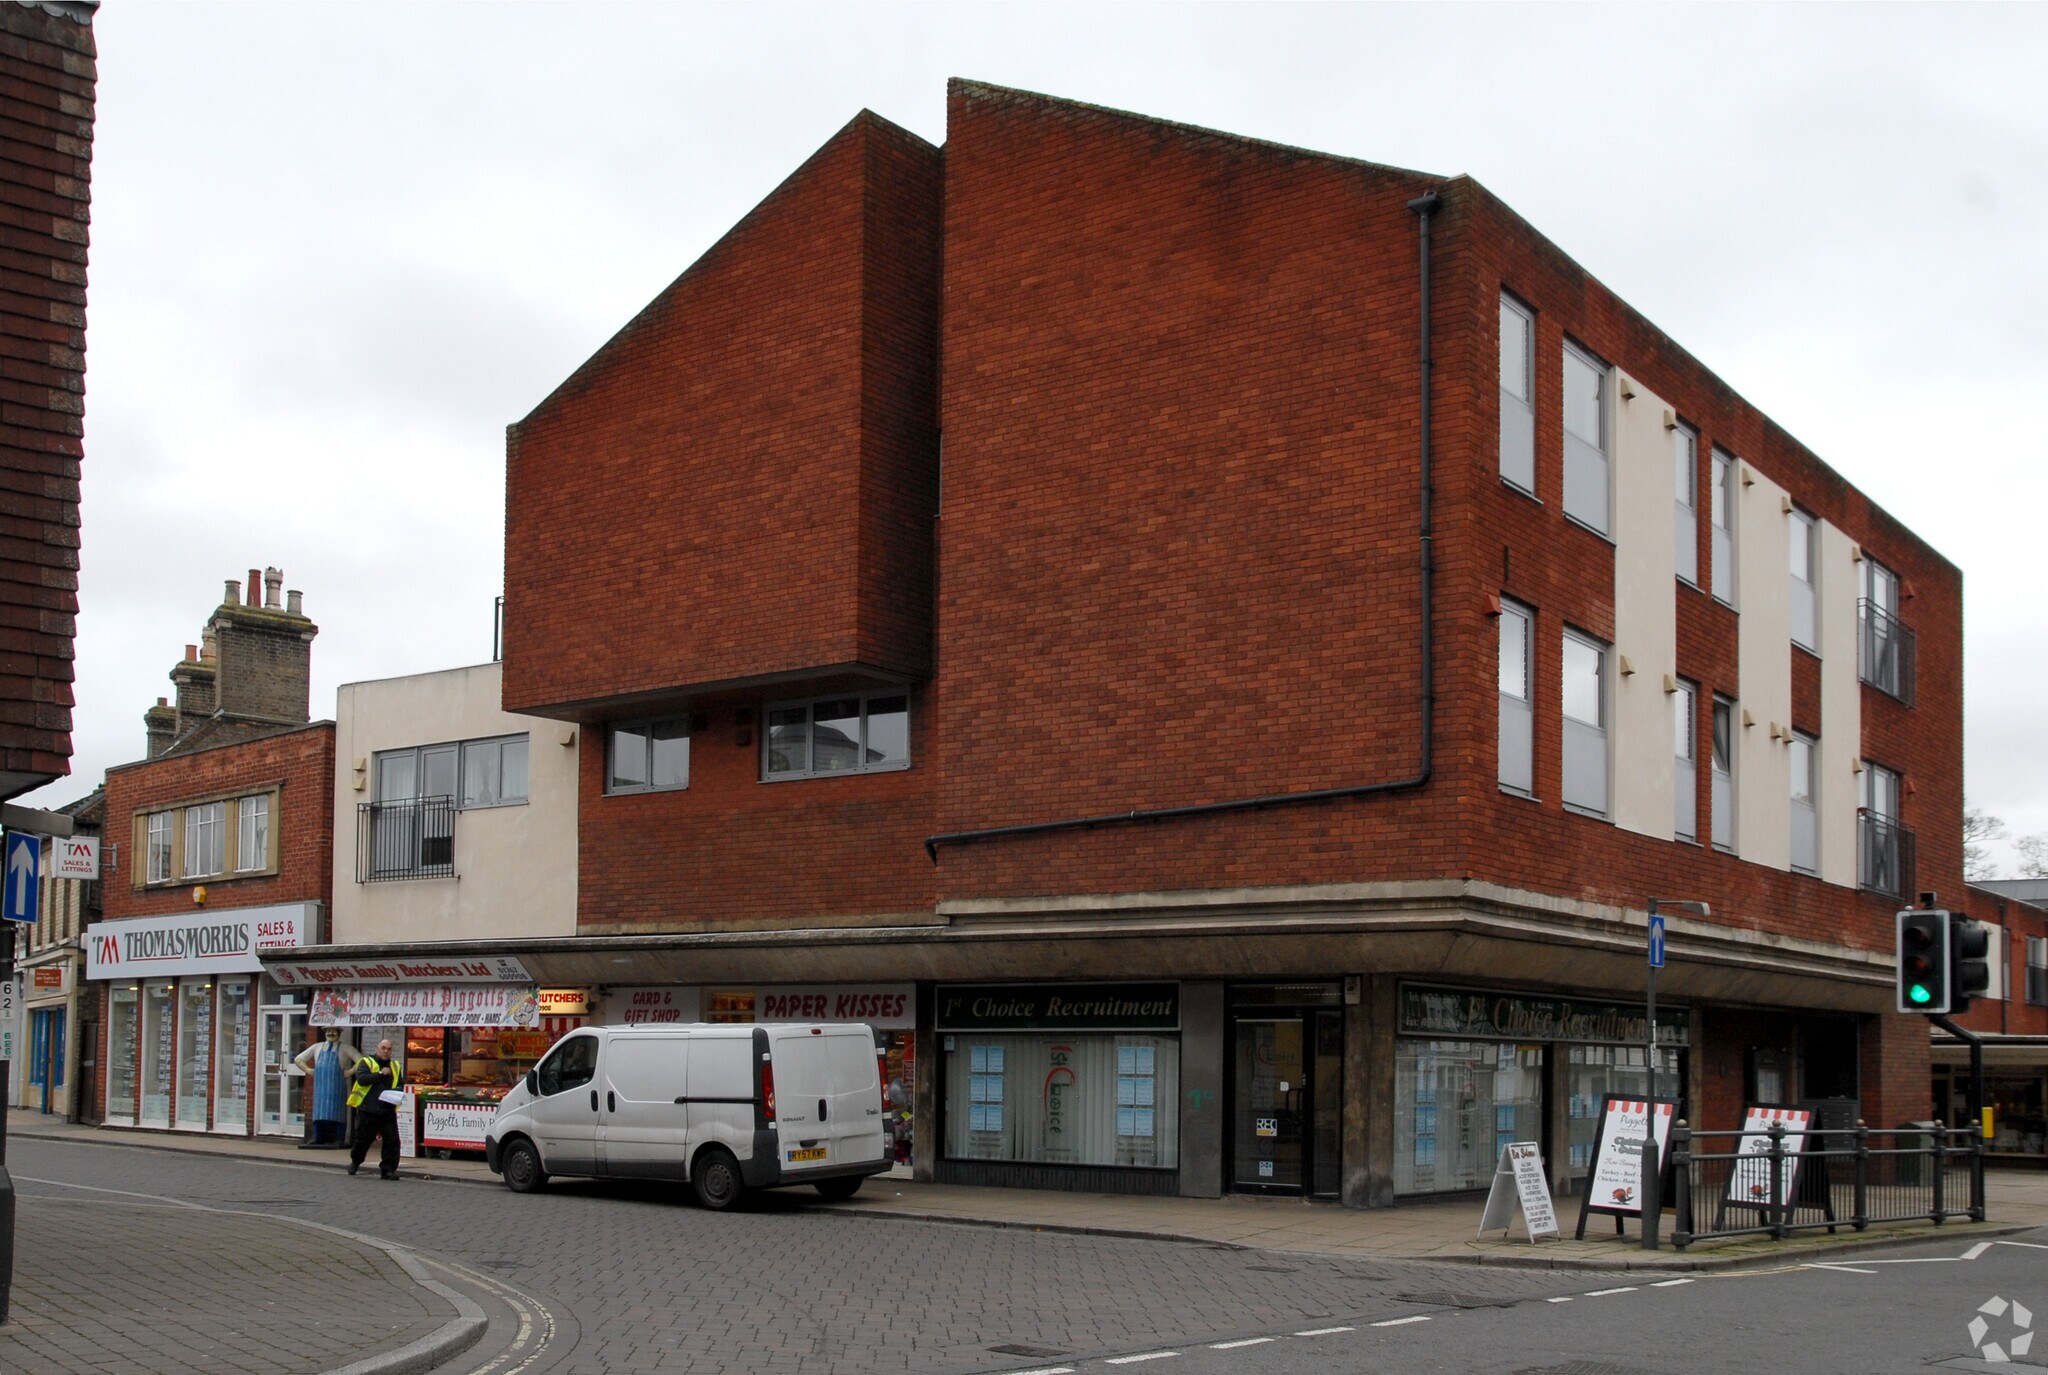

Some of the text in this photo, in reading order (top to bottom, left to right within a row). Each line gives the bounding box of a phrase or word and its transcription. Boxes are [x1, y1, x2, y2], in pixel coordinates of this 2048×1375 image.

[257, 920, 295, 937] SALES &
[351, 964, 399, 981] Family
[397, 963, 464, 977] Butchers
[461, 962, 492, 977] Ltd
[349, 986, 505, 1012] Christmas at Piggotts
[633, 991, 672, 1005] CARD &
[764, 994, 907, 1019] PAPER KISSES
[944, 997, 1173, 1017] 1st Choice Recruitment
[403, 1013, 421, 1024] GEESE
[424, 1013, 444, 1024] DUCKS
[447, 1013, 462, 1024] BEEF
[464, 1013, 481, 1024] PORK
[624, 1009, 680, 1022] GIFT SHOP
[1494, 997, 1553, 1034] Choice
[1558, 1002, 1648, 1041] Recruitmen
[427, 1112, 459, 1131] Piggotts
[462, 1117, 486, 1131] Family
[792, 1149, 811, 1160] RY57
